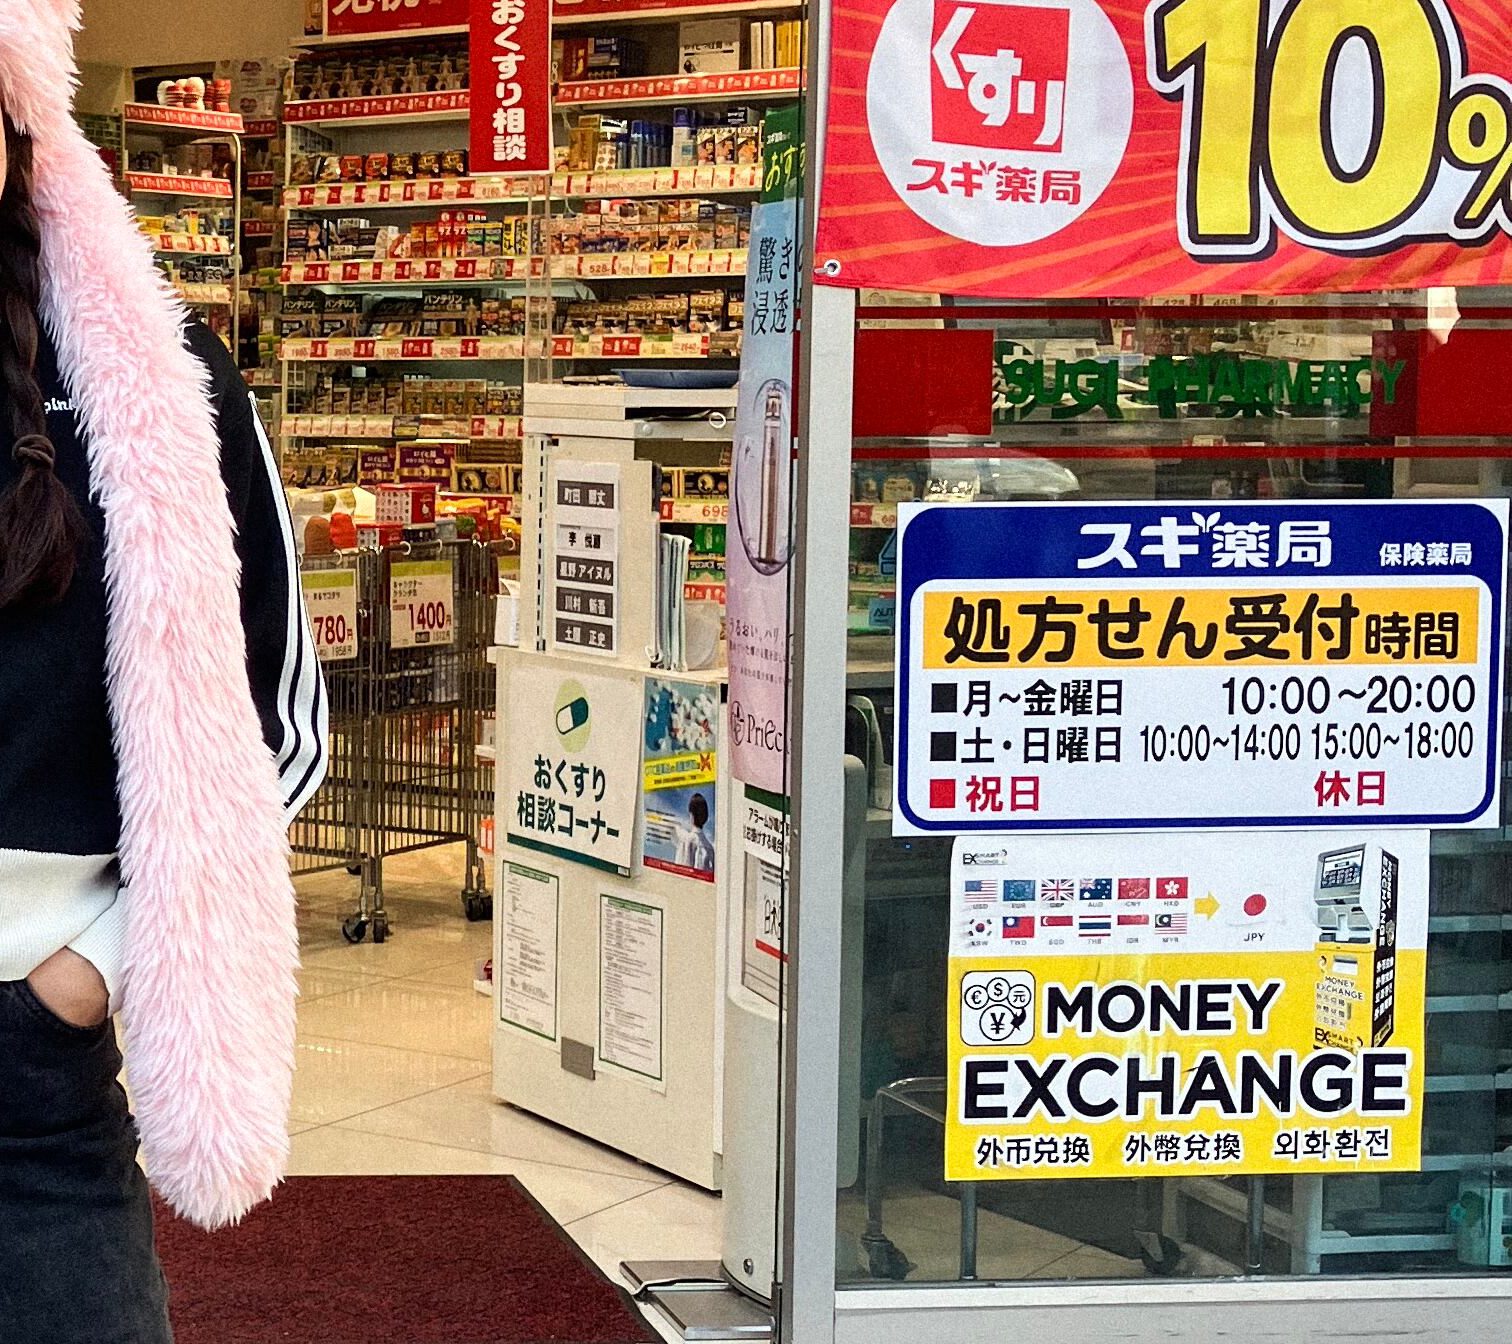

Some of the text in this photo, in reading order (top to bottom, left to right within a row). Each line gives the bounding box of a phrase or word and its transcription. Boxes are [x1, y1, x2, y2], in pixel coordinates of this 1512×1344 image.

[931, 6, 1065, 146] くすり
[906, 160, 1081, 206] スギ薬局
[1077, 512, 1472, 569] スギ薬局 保険薬局
[944, 593, 1460, 664] 処方せん受付時間
[533, 753, 607, 803] おくすり
[965, 769, 1387, 813] 祝日 休日
[517, 790, 620, 848] 相談コーナー
[1243, 932, 1266, 943] JPY
[1046, 982, 1282, 1035] MONEY
[963, 1052, 1407, 1122] EXCHANGE
[975, 1137, 1092, 1167] 外币兑换
[1274, 1127, 1390, 1159] 외화환전
